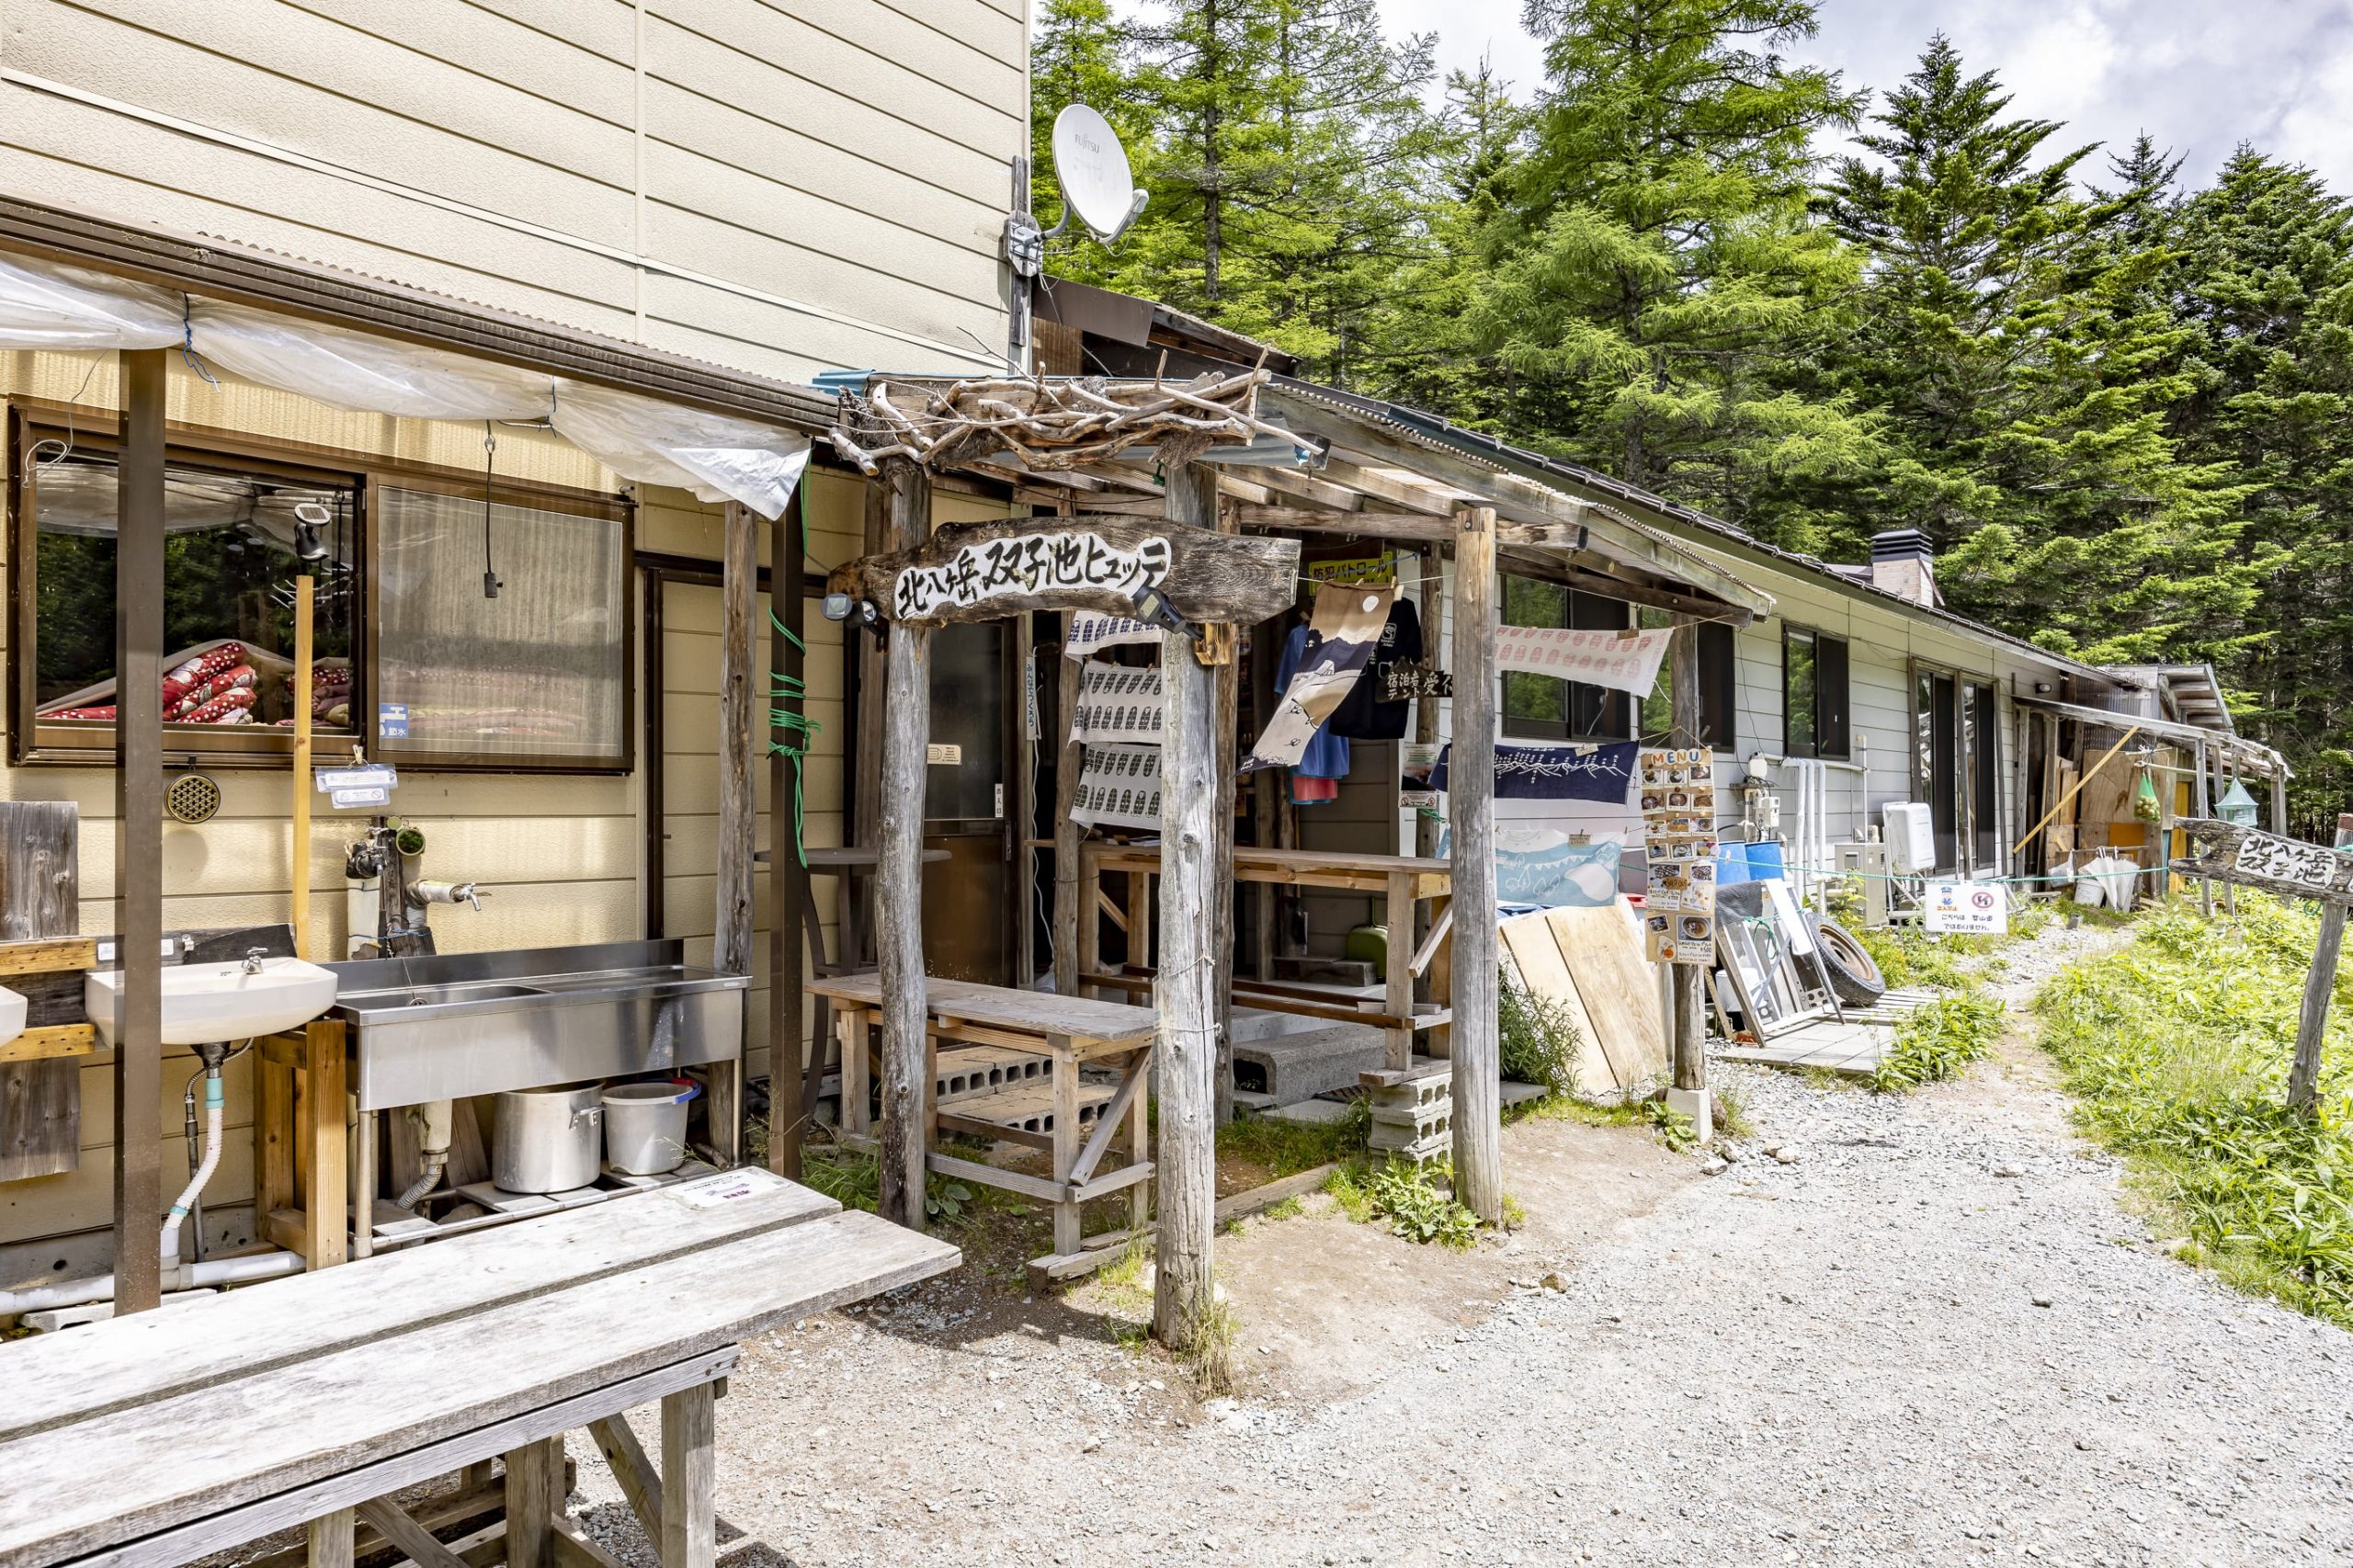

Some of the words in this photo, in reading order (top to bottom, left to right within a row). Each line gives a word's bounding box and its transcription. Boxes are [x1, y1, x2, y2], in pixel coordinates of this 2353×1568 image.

[1074, 133, 1100, 153] FUJITSU
[1387, 669, 1420, 687] 宿泊者
[1388, 687, 1420, 699] テント
[1653, 751, 1699, 764] MENU
